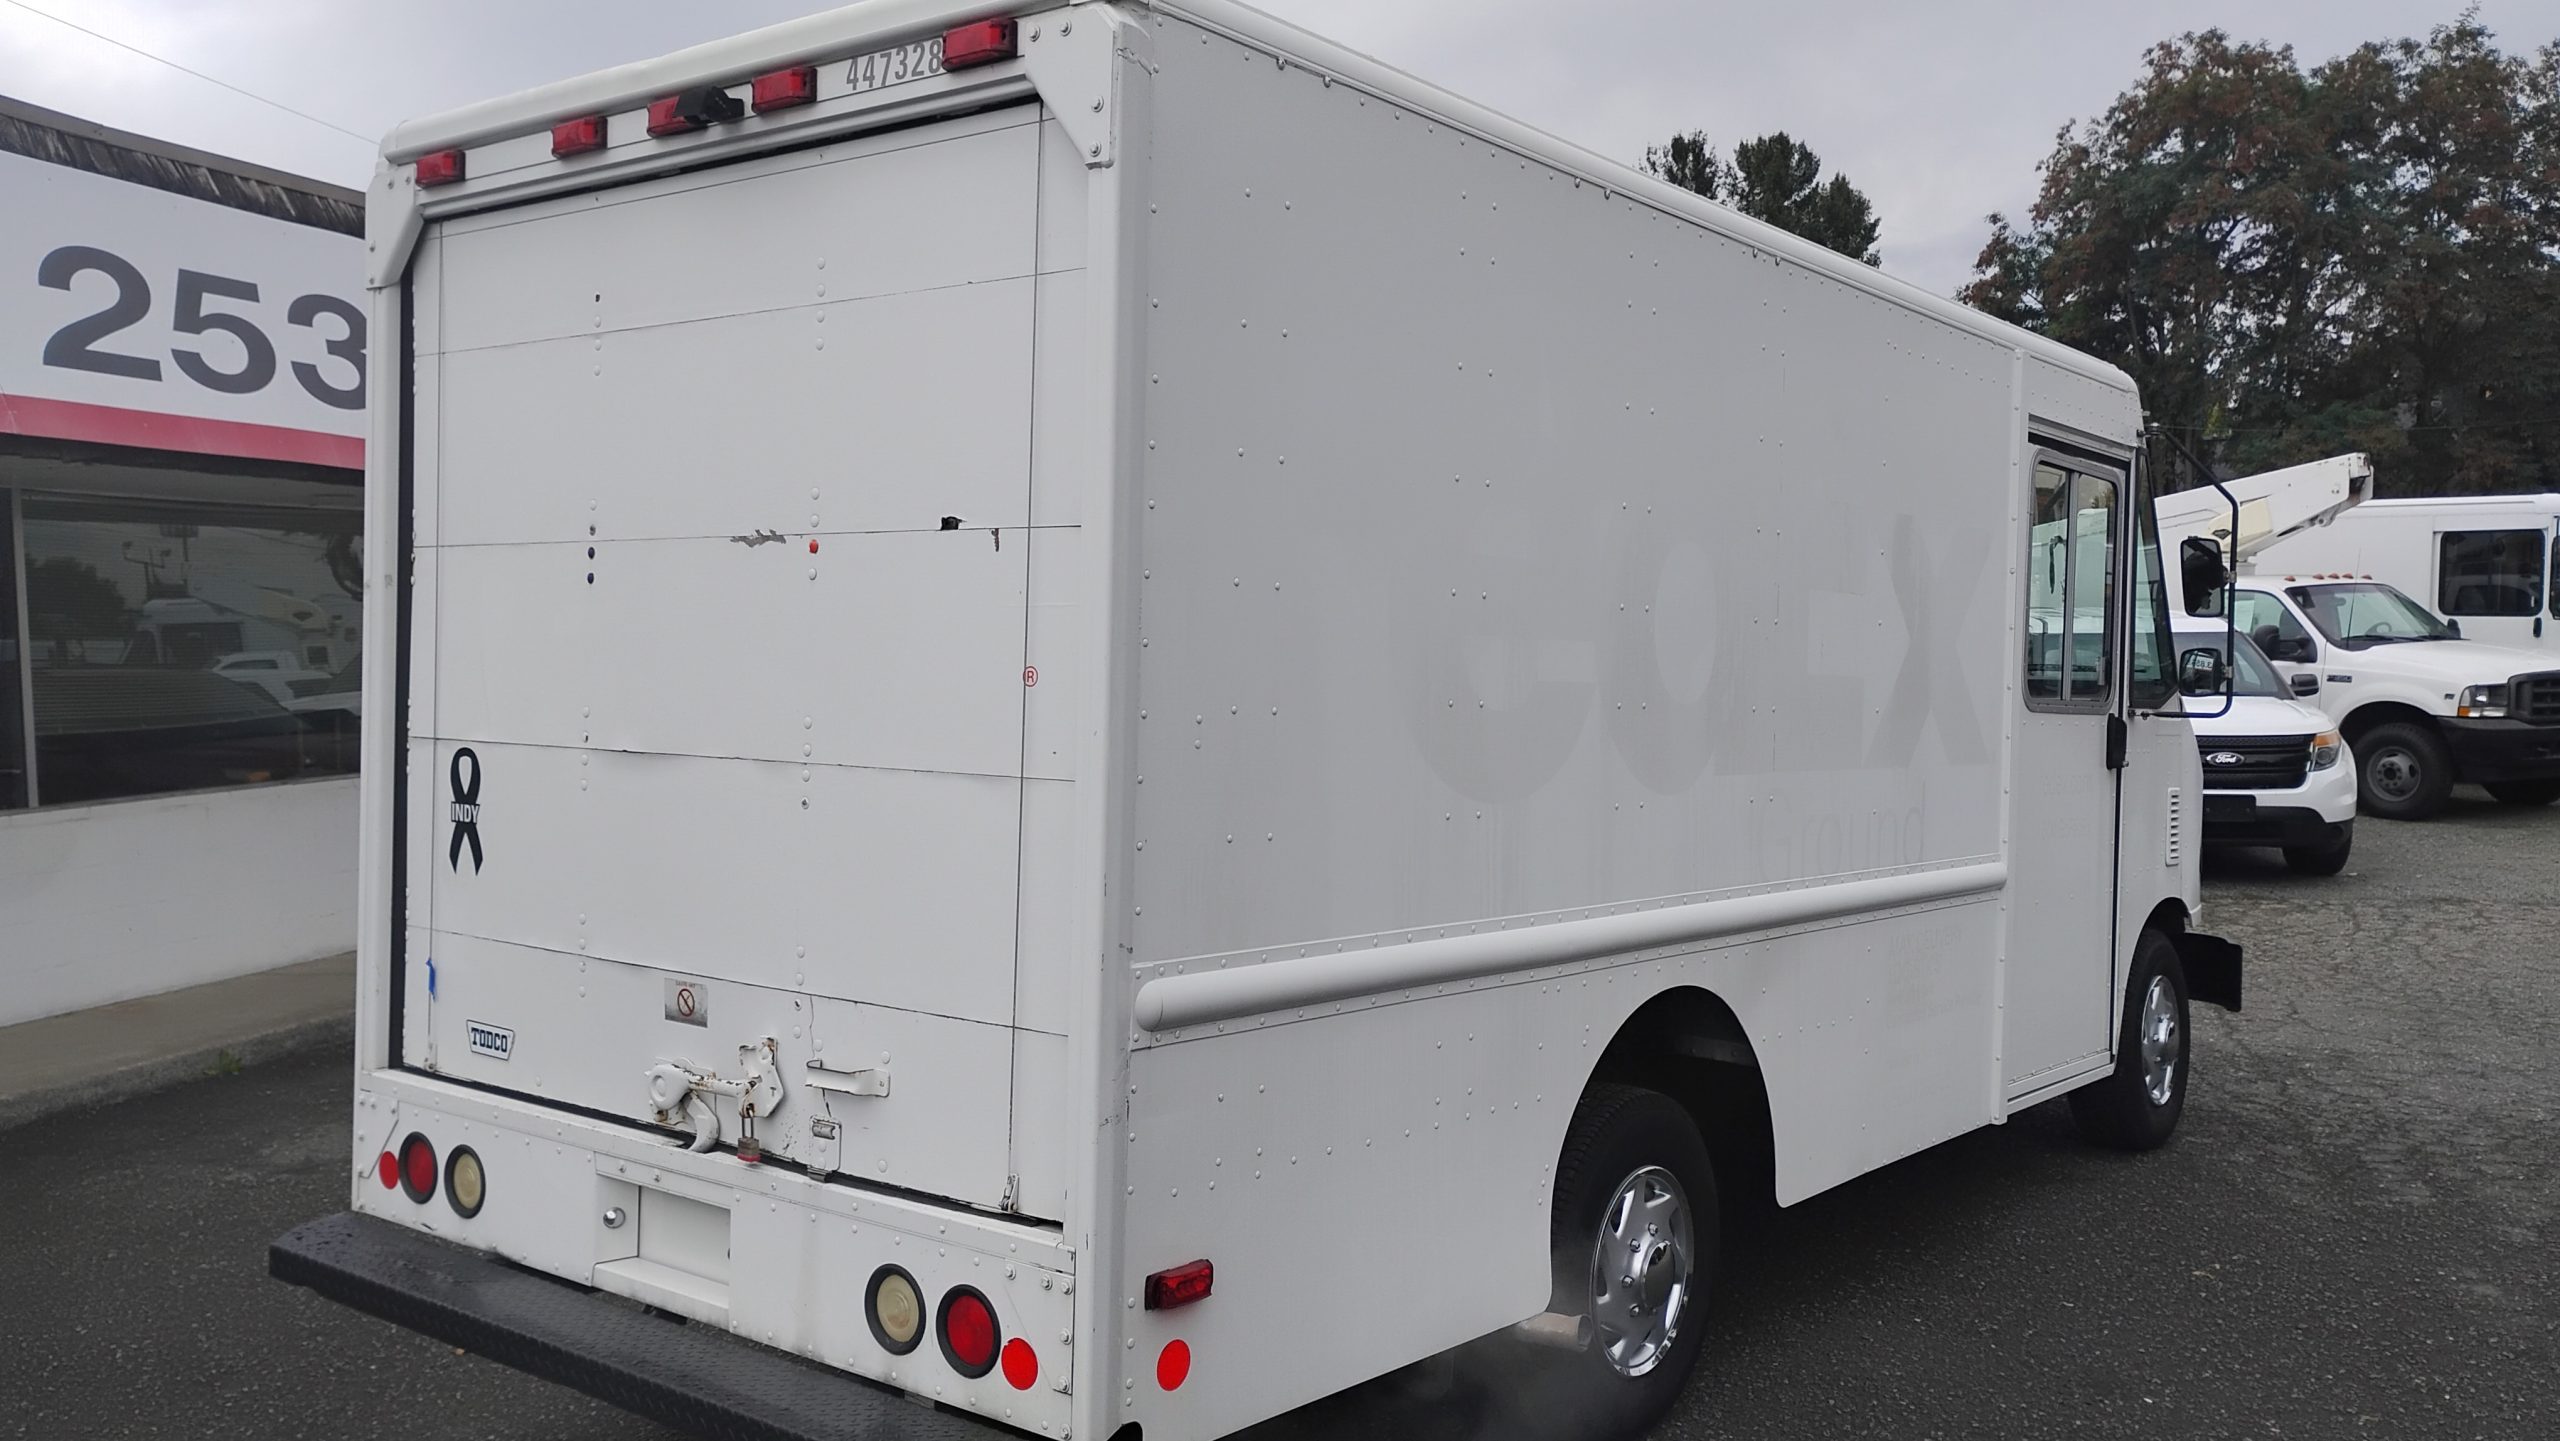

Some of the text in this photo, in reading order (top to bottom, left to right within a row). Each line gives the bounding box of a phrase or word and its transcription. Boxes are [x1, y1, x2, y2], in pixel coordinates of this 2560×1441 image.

[846, 39, 942, 91] 447328
[38, 245, 366, 411] 253
[451, 802, 480, 823] INDY
[471, 1026, 508, 1053] TODCO
